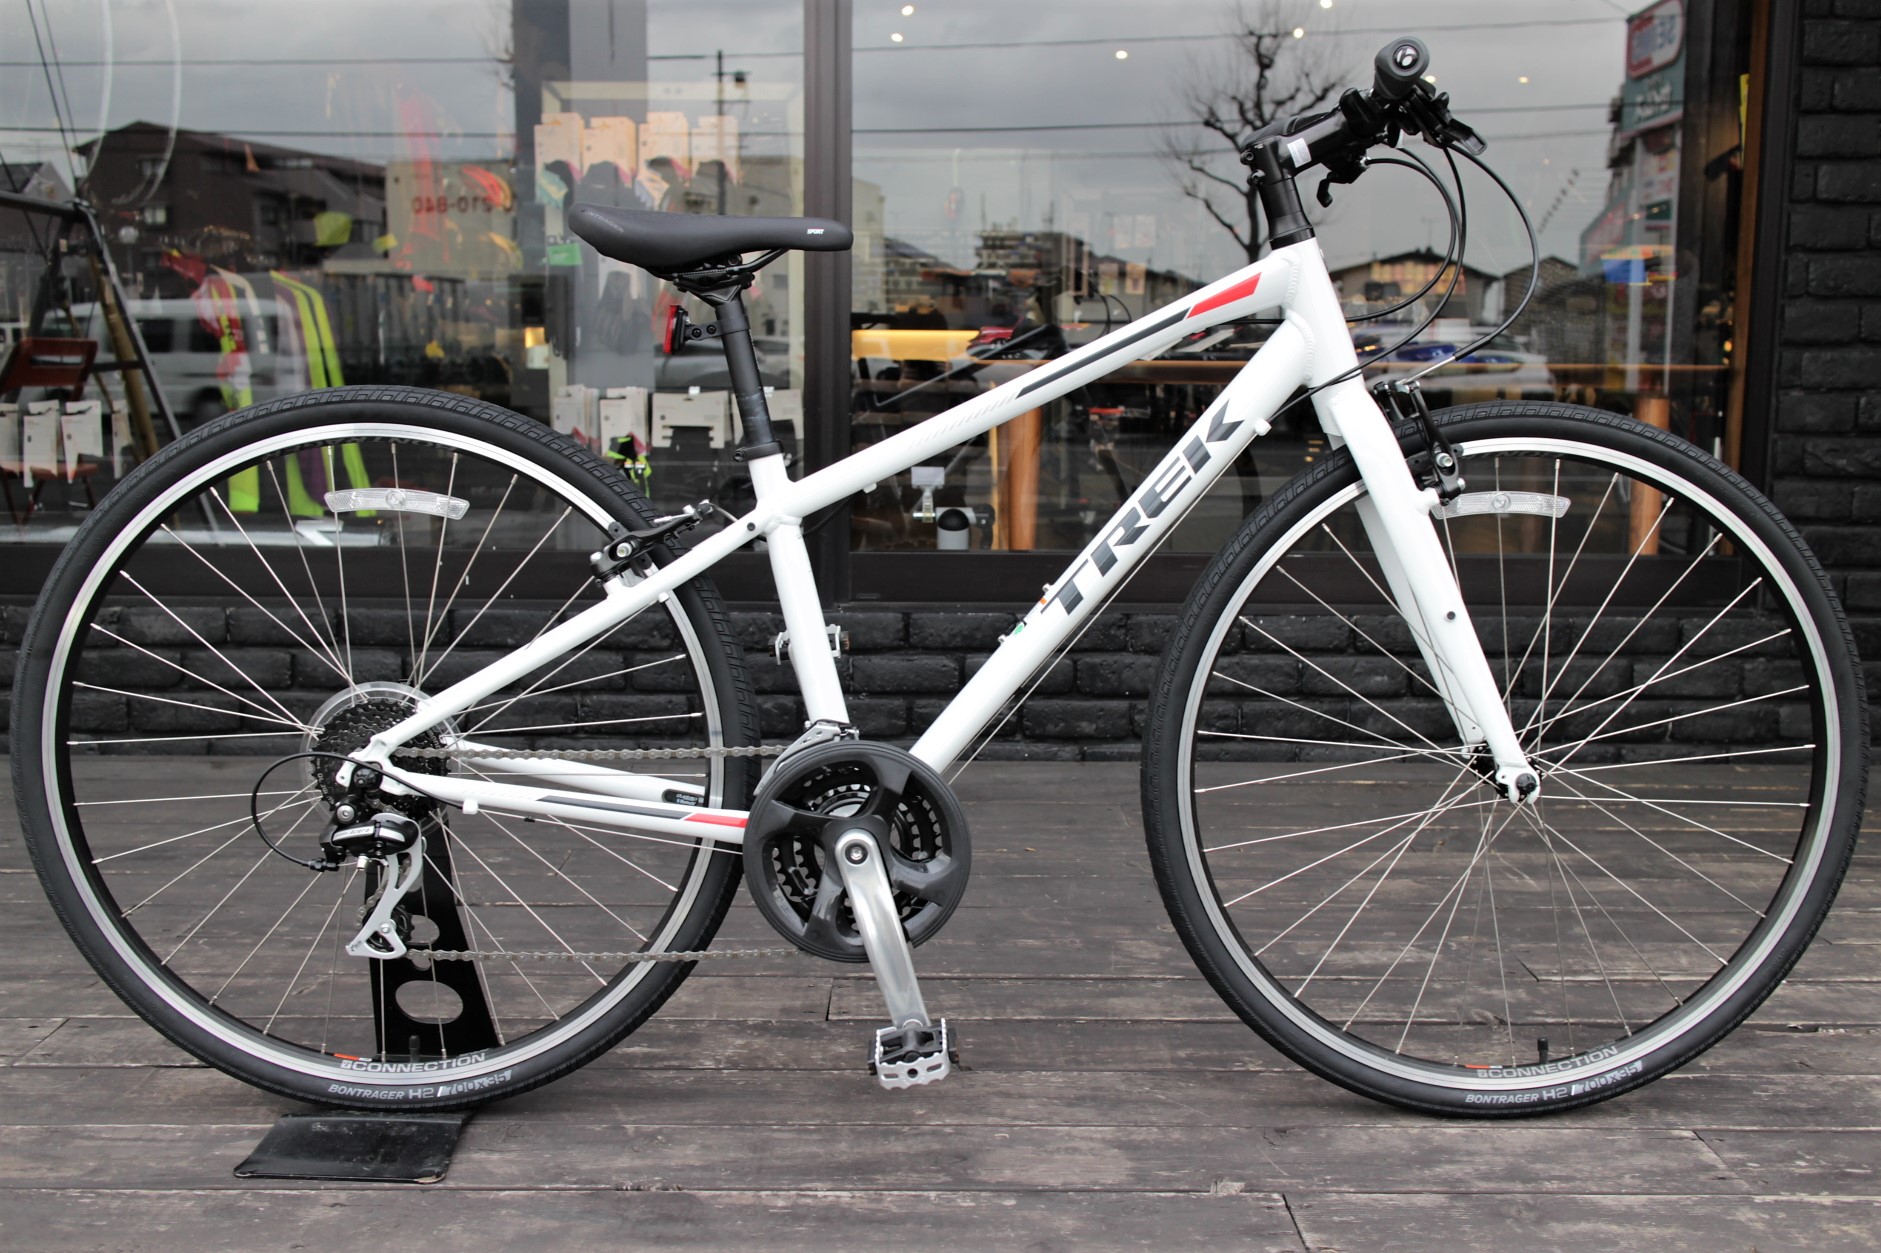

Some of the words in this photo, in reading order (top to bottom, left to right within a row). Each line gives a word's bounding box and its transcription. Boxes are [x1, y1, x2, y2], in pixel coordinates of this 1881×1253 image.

[1040, 398, 1245, 616] TREK
[352, 1053, 486, 1073] CONNECTION
[1488, 1045, 1619, 1078] CONNECTION
[328, 1083, 405, 1100] BONTRAGER
[408, 1087, 434, 1100] H2
[1466, 1093, 1539, 1104] BONTRAGER
[1542, 1087, 1569, 1101] H2
